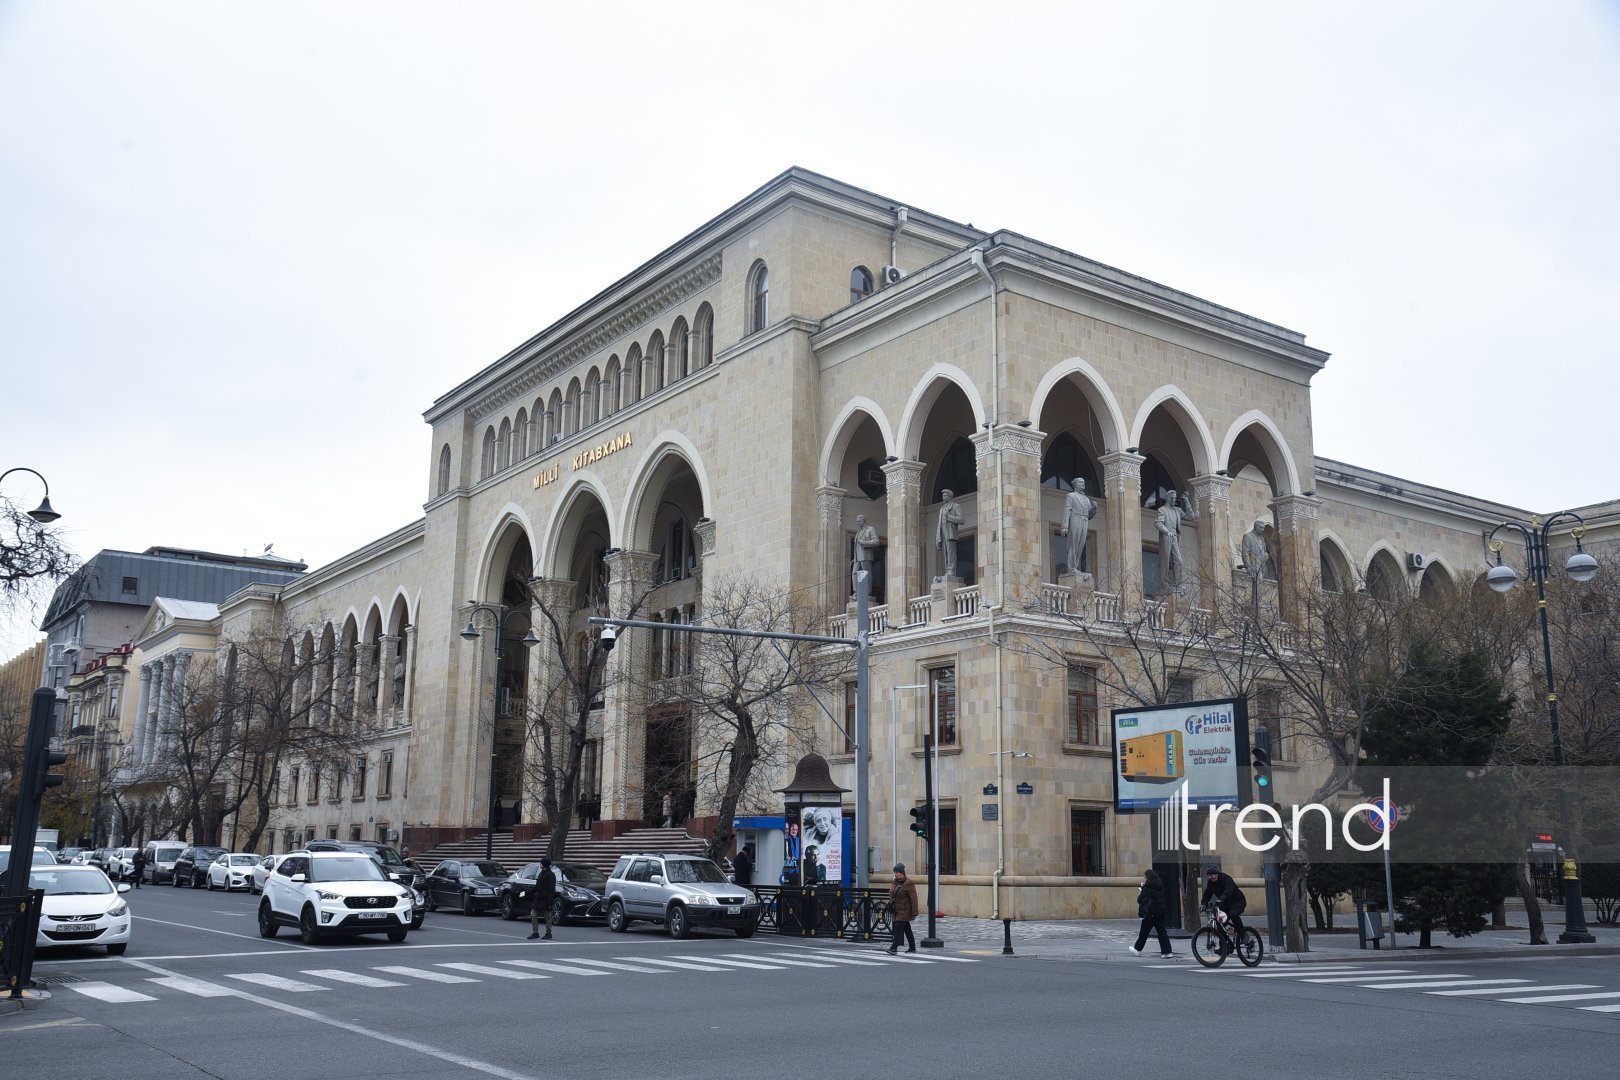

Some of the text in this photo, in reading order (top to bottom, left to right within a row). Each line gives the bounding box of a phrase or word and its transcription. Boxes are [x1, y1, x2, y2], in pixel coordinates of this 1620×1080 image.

[533, 432, 633, 490] MİLLİ KİTABXANA
[1203, 711, 1232, 726] Hilal
[1203, 724, 1232, 735] Elektrik
